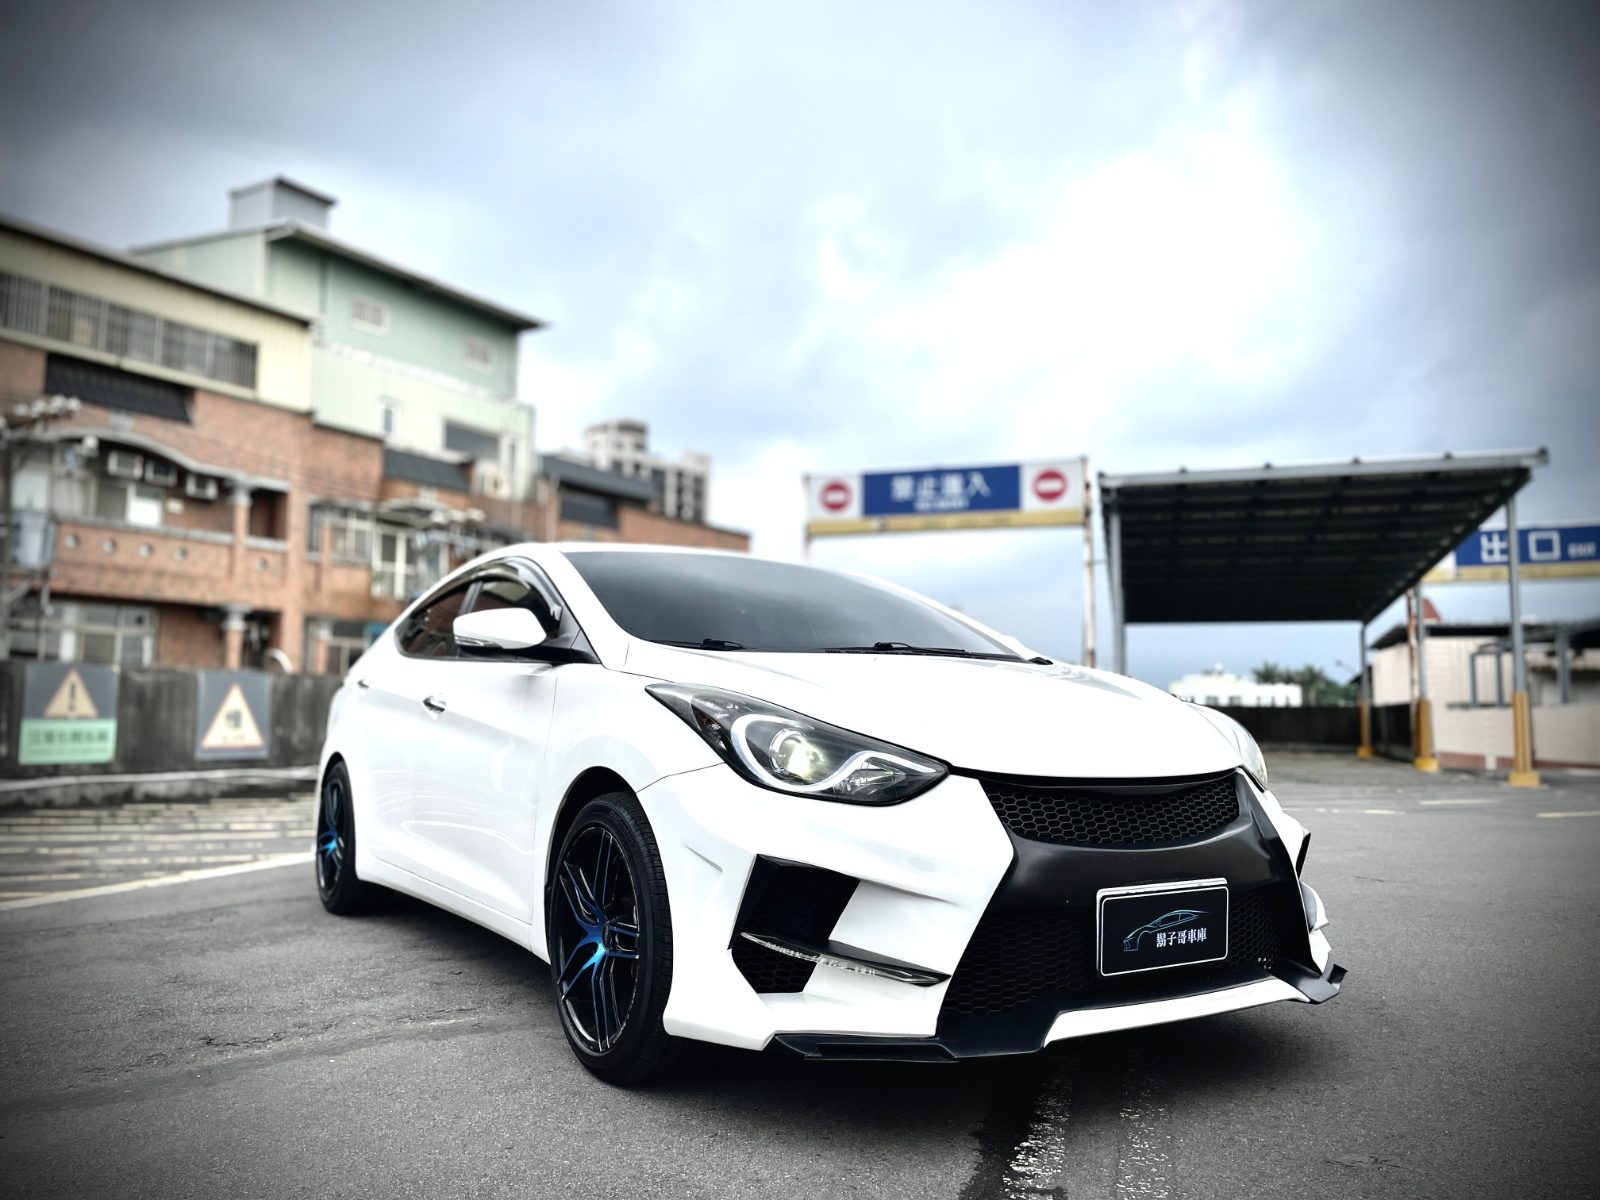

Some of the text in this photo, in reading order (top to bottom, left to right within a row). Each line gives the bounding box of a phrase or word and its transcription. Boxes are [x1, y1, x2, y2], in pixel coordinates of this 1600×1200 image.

[1480, 530, 1561, 563] 出口
[1156, 927, 1207, 948] 鬍子哥車庫
